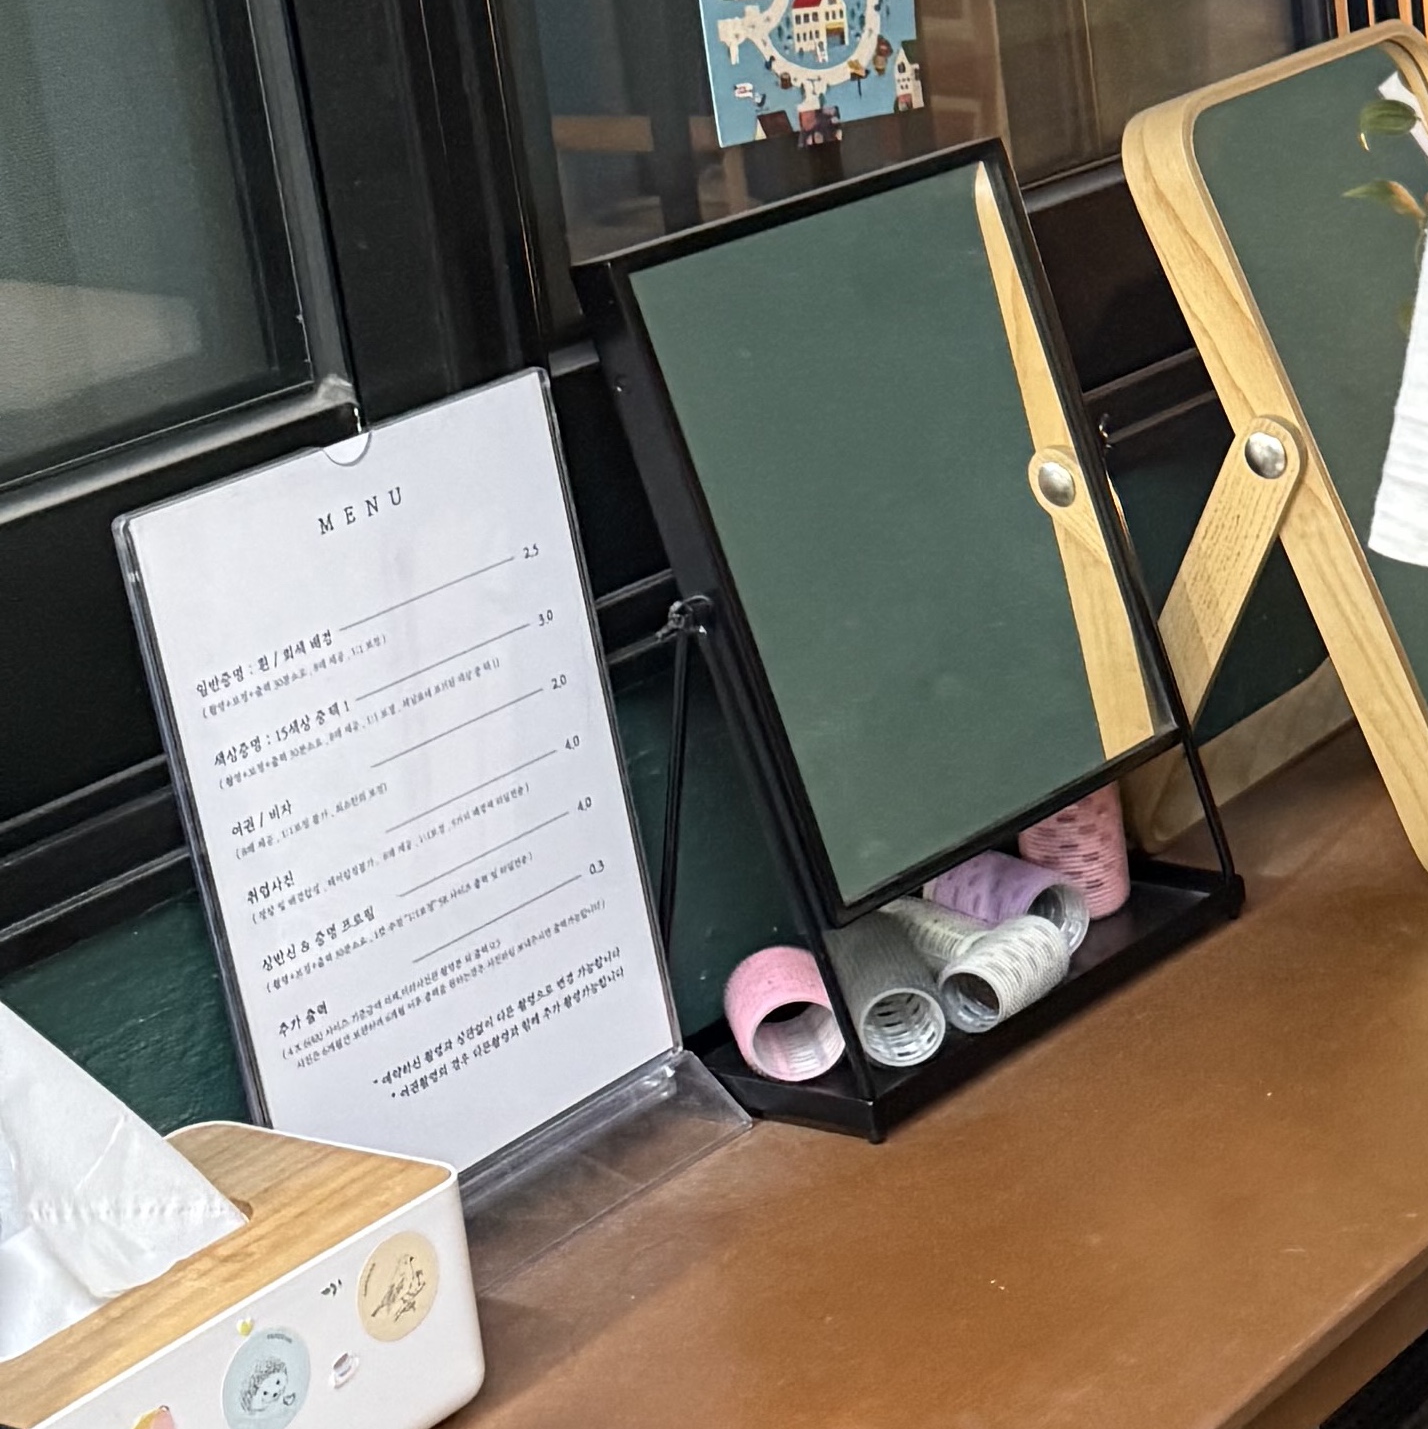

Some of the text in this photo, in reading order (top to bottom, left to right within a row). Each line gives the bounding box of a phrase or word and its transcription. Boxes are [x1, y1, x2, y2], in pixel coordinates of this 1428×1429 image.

[317, 486, 401, 535] MENU
[522, 542, 539, 559] 2.5
[538, 609, 553, 626] 3.0
[550, 673, 567, 690] 2.0
[214, 735, 261, 766] 색상증명
[275, 714, 310, 742] 15색상
[564, 734, 580, 750] 4.0
[231, 815, 255, 836] 여권
[268, 799, 291, 819] 비자
[577, 796, 592, 811] 4.0
[247, 869, 294, 905] 취업사진
[262, 943, 296, 972] 상반신
[314, 922, 337, 947] 증명
[341, 905, 375, 933] 프로필
[278, 1000, 328, 1037] 추가 출력
